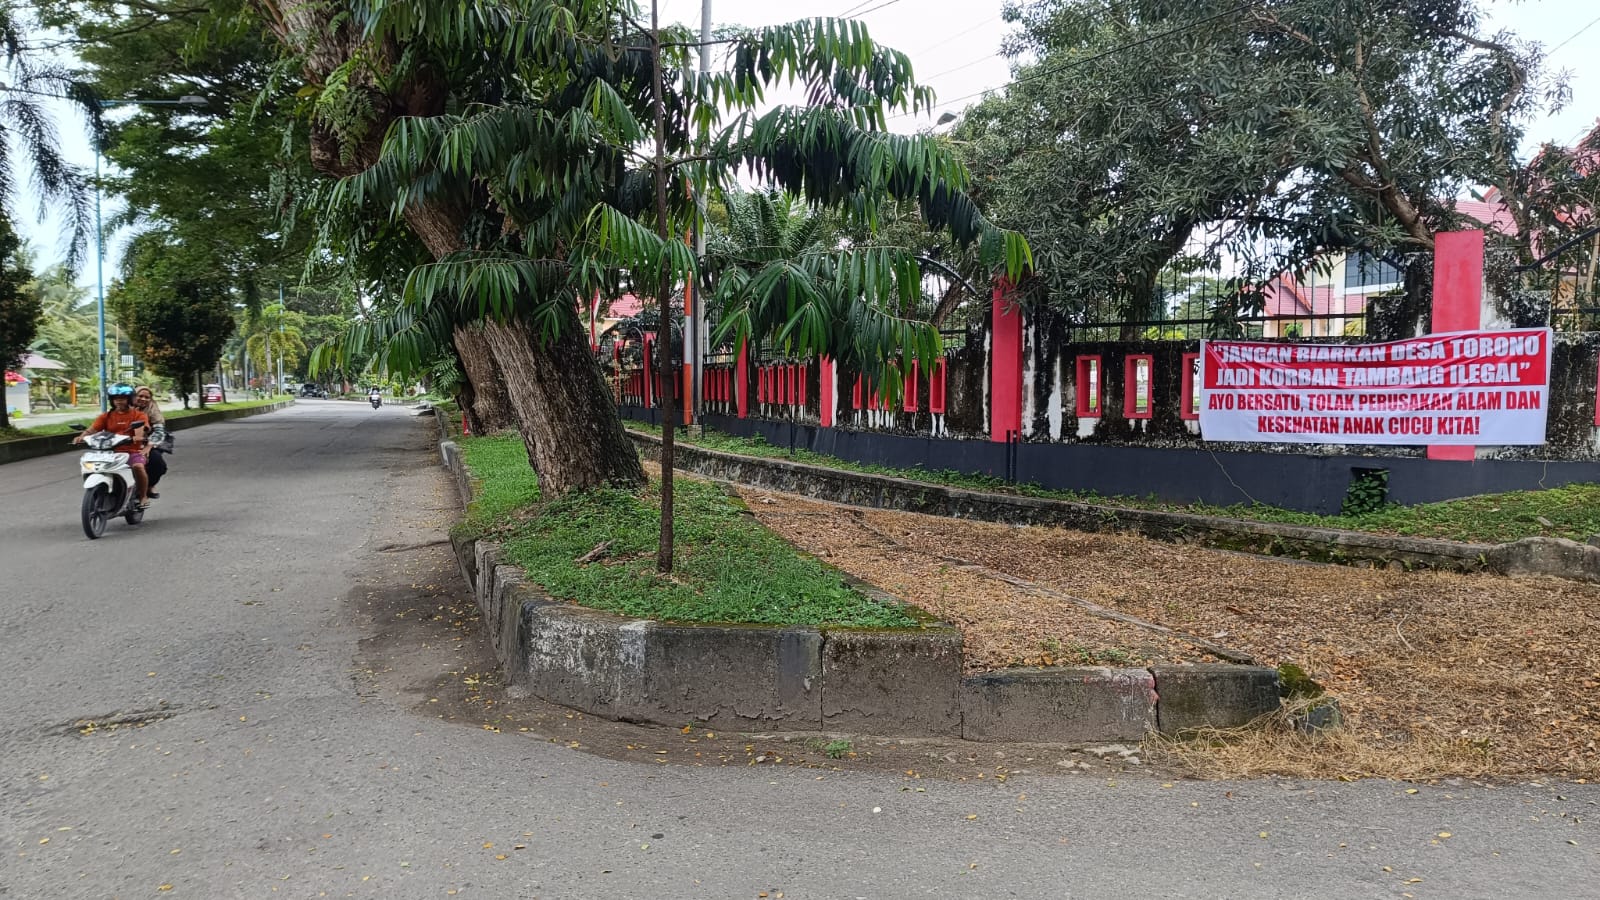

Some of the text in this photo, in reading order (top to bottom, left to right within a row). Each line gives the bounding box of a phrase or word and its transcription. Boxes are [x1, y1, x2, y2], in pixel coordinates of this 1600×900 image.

[1297, 346, 1386, 362] BIARKAN
[1391, 341, 1446, 361] DESA
[1450, 335, 1540, 359] TORONO
[1216, 368, 1255, 386] JADI
[1259, 367, 1338, 387] KORBAN
[1344, 365, 1444, 386] TAMBANG
[1208, 390, 1541, 412] AYO BERSATU, TOLAK PERUSAKAN ALAM DAN
[1257, 415, 1481, 435] KESEHATAN ANAK CUCU KITA!
